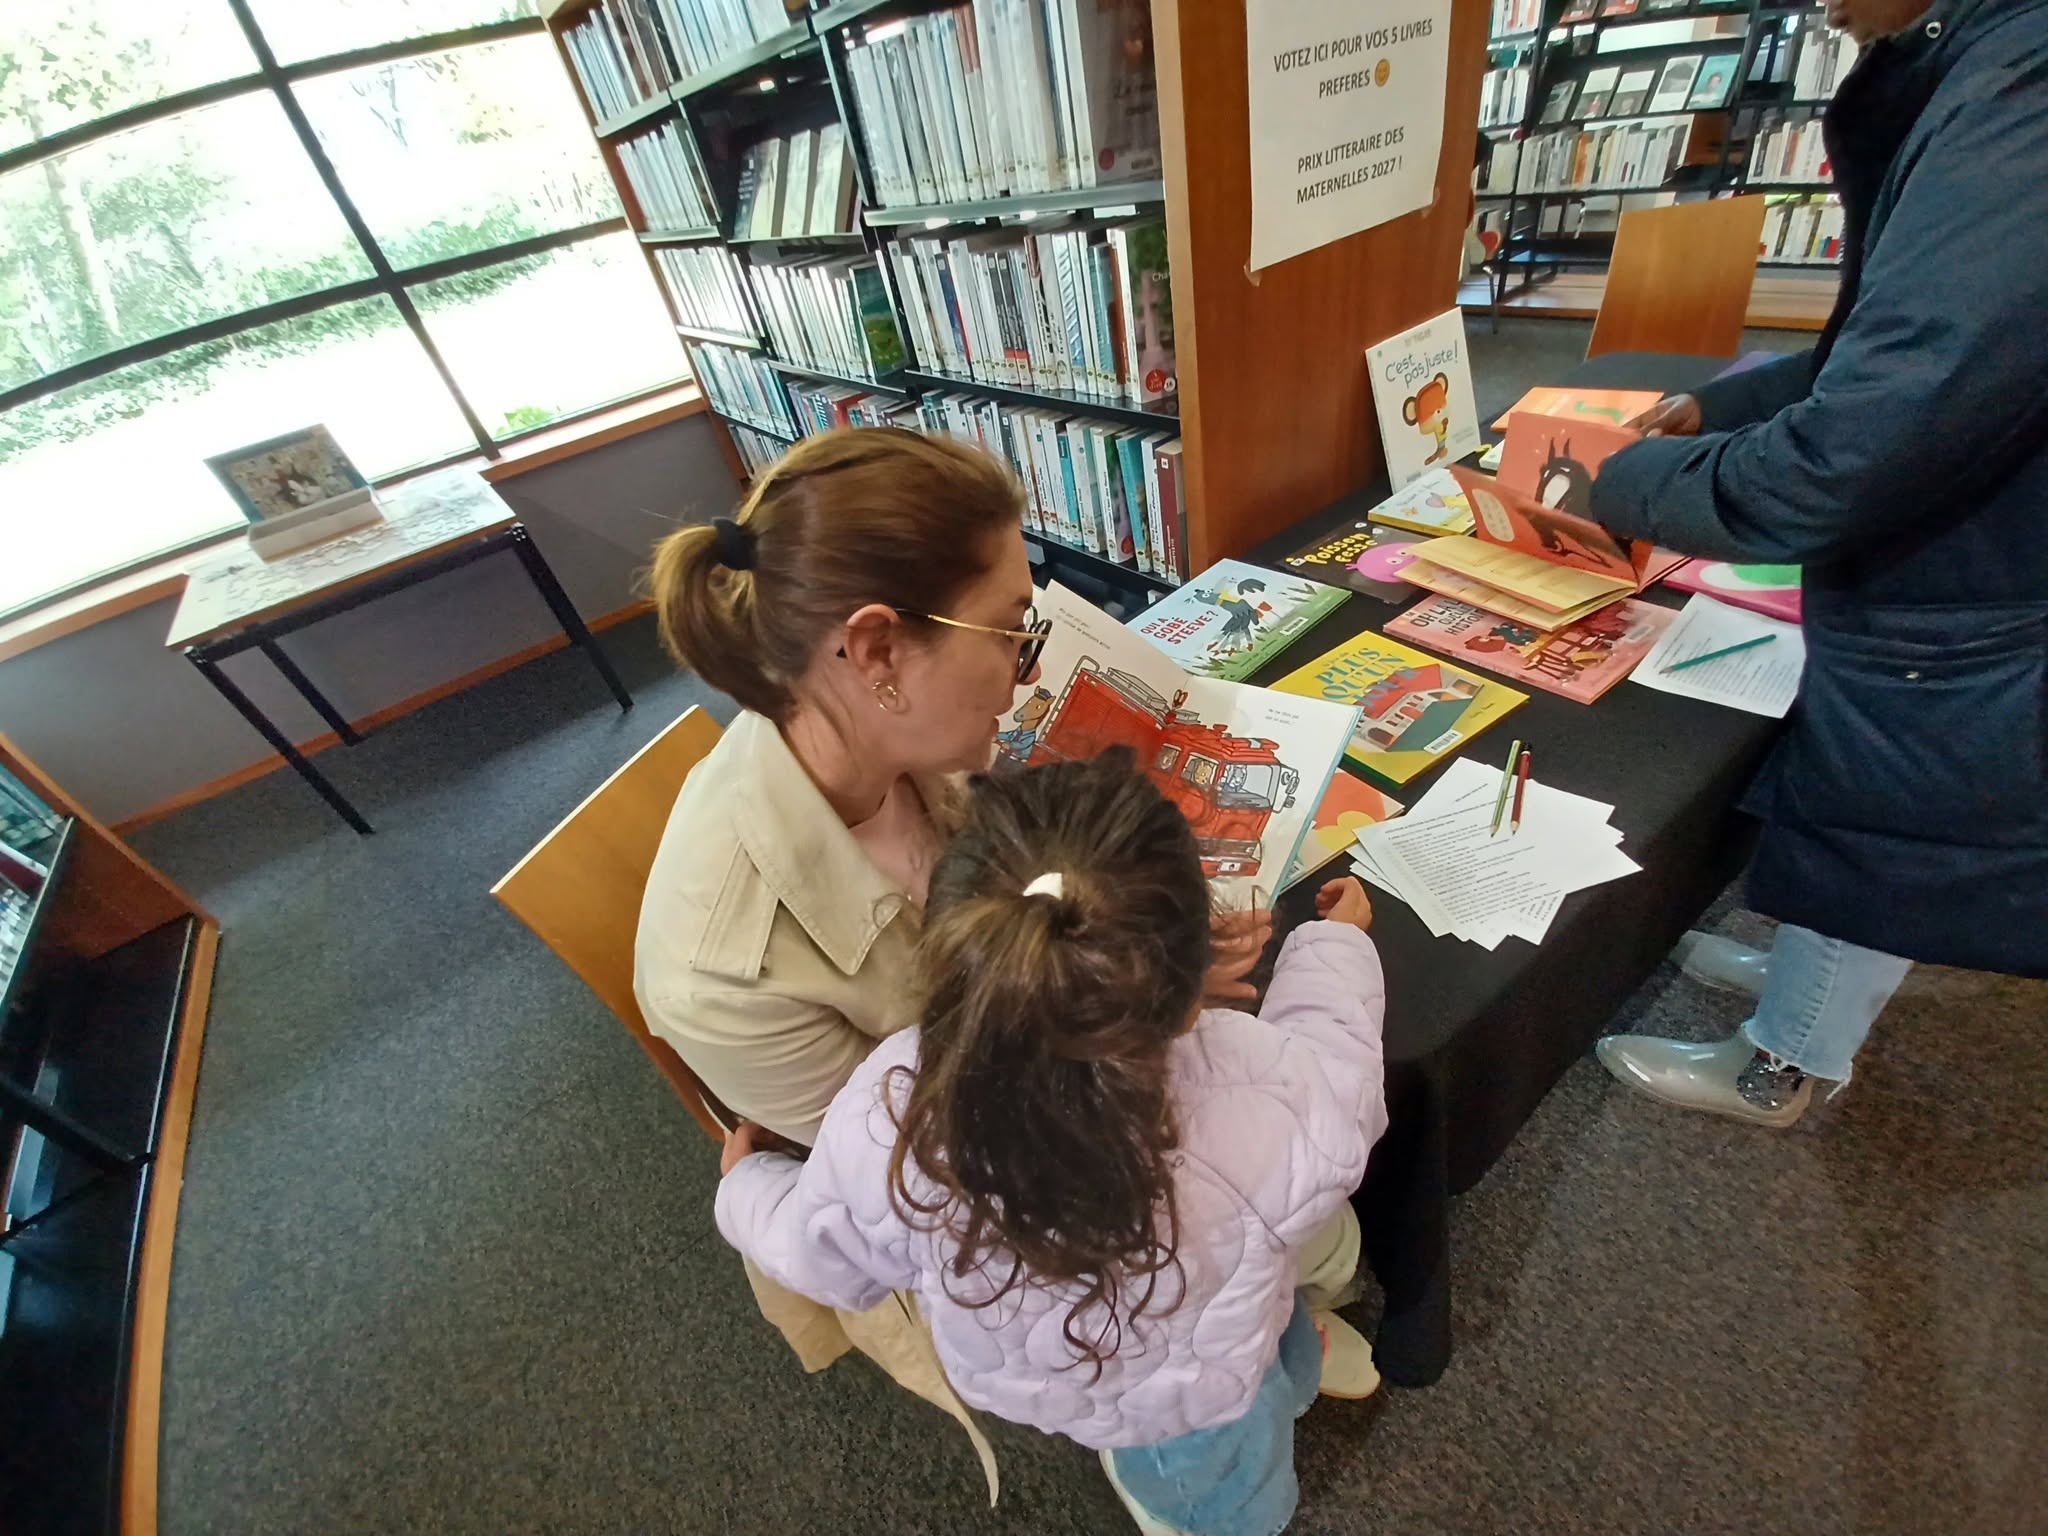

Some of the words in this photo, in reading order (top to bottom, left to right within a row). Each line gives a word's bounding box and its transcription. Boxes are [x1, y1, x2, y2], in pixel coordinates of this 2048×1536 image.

[1274, 47, 1311, 72] VOTEZ
[1314, 44, 1328, 63] ICI
[1332, 36, 1362, 59] POUR
[1365, 29, 1388, 51] VOS
[1391, 27, 1399, 44] 5
[1400, 18, 1432, 42] LIVRES
[1319, 69, 1370, 99] PREFERES
[1297, 151, 1322, 174] PRIX
[1325, 133, 1382, 165] LITTERAIRE
[1385, 127, 1404, 147] DES
[1296, 167, 1368, 204] MATERNELLES
[1371, 158, 1396, 180] 2027
[1385, 353, 1415, 382] C'est
[1404, 362, 1425, 389] pas
[1304, 533, 1371, 564] Poisson
[1140, 622, 1161, 635] QUI
[1153, 616, 1188, 639] GOBÉ
[1167, 615, 1212, 645] STEEVE
[1410, 612, 1438, 627] OH
[1315, 648, 1380, 684] PLUS
[1322, 653, 1405, 699] QU'UN
